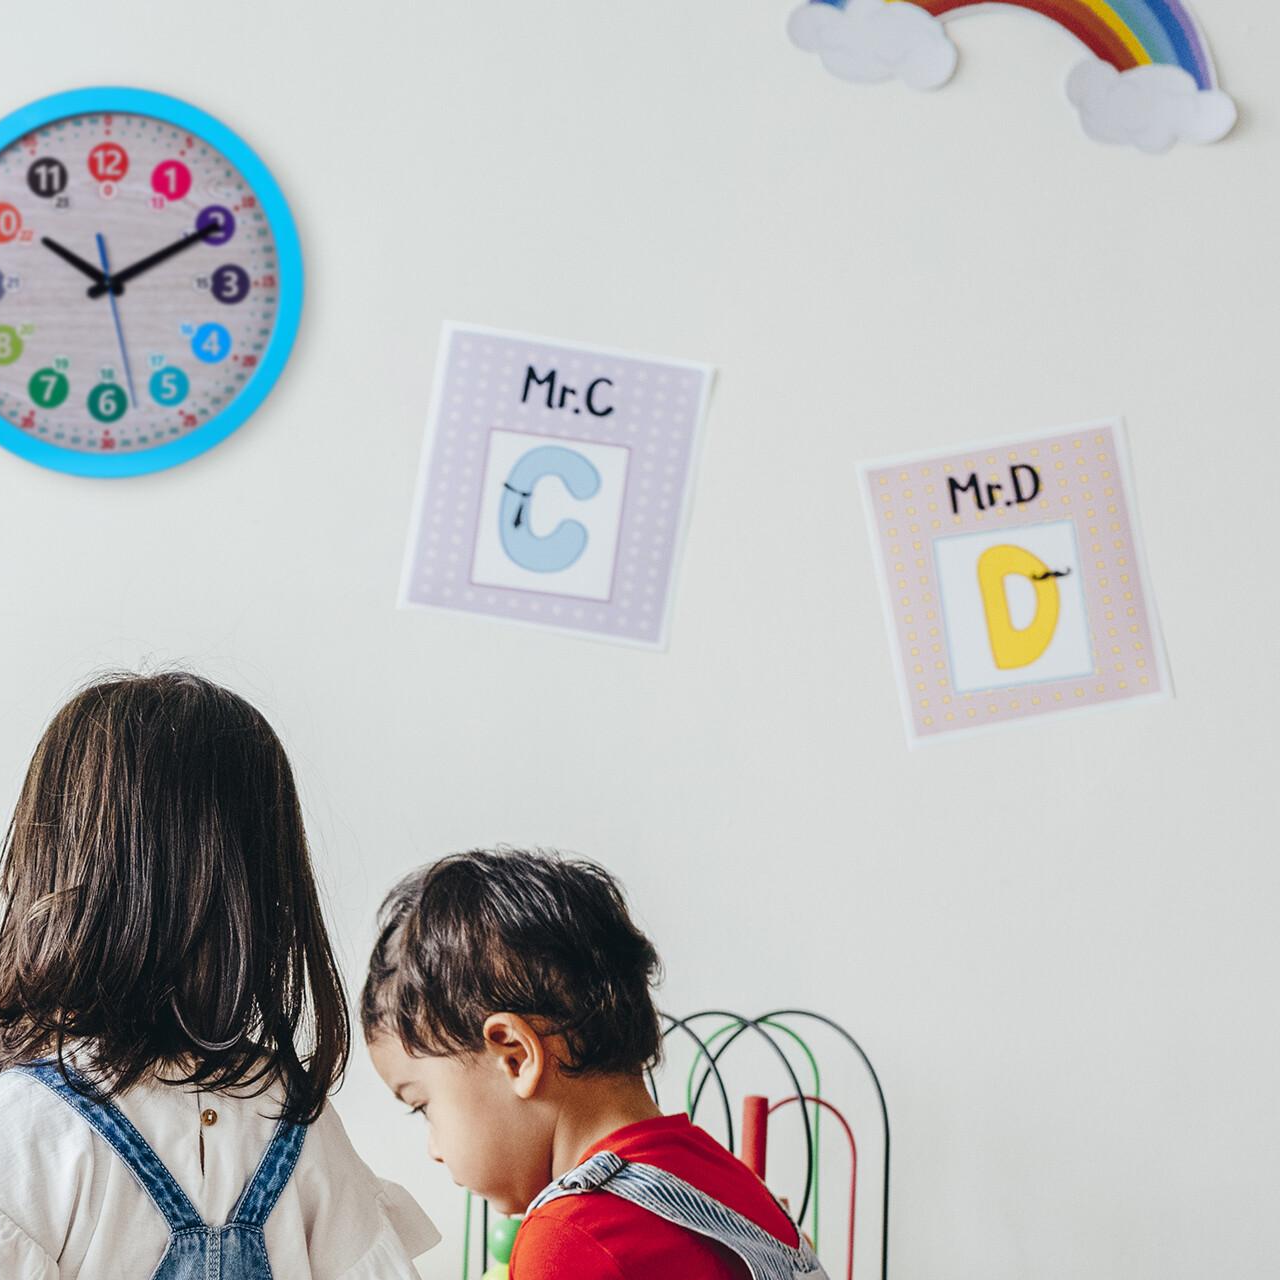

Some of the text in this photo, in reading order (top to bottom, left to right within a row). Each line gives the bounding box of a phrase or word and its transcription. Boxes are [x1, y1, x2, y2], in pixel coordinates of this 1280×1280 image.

[94, 149, 122, 176] 12
[34, 165, 61, 192] 11
[103, 184, 113, 196] 0
[165, 168, 177, 194] 1
[56, 197, 69, 208] 23
[151, 197, 164, 209] 13
[196, 278, 209, 289] 15
[221, 271, 239, 298] 3
[201, 331, 221, 356] 4
[38, 375, 58, 402] 7
[160, 373, 178, 400] 5
[521, 365, 614, 417] Mr.C
[98, 390, 117, 416] 6
[946, 463, 1040, 515] Mr.D
[498, 444, 602, 574] C
[976, 543, 1061, 671] D
